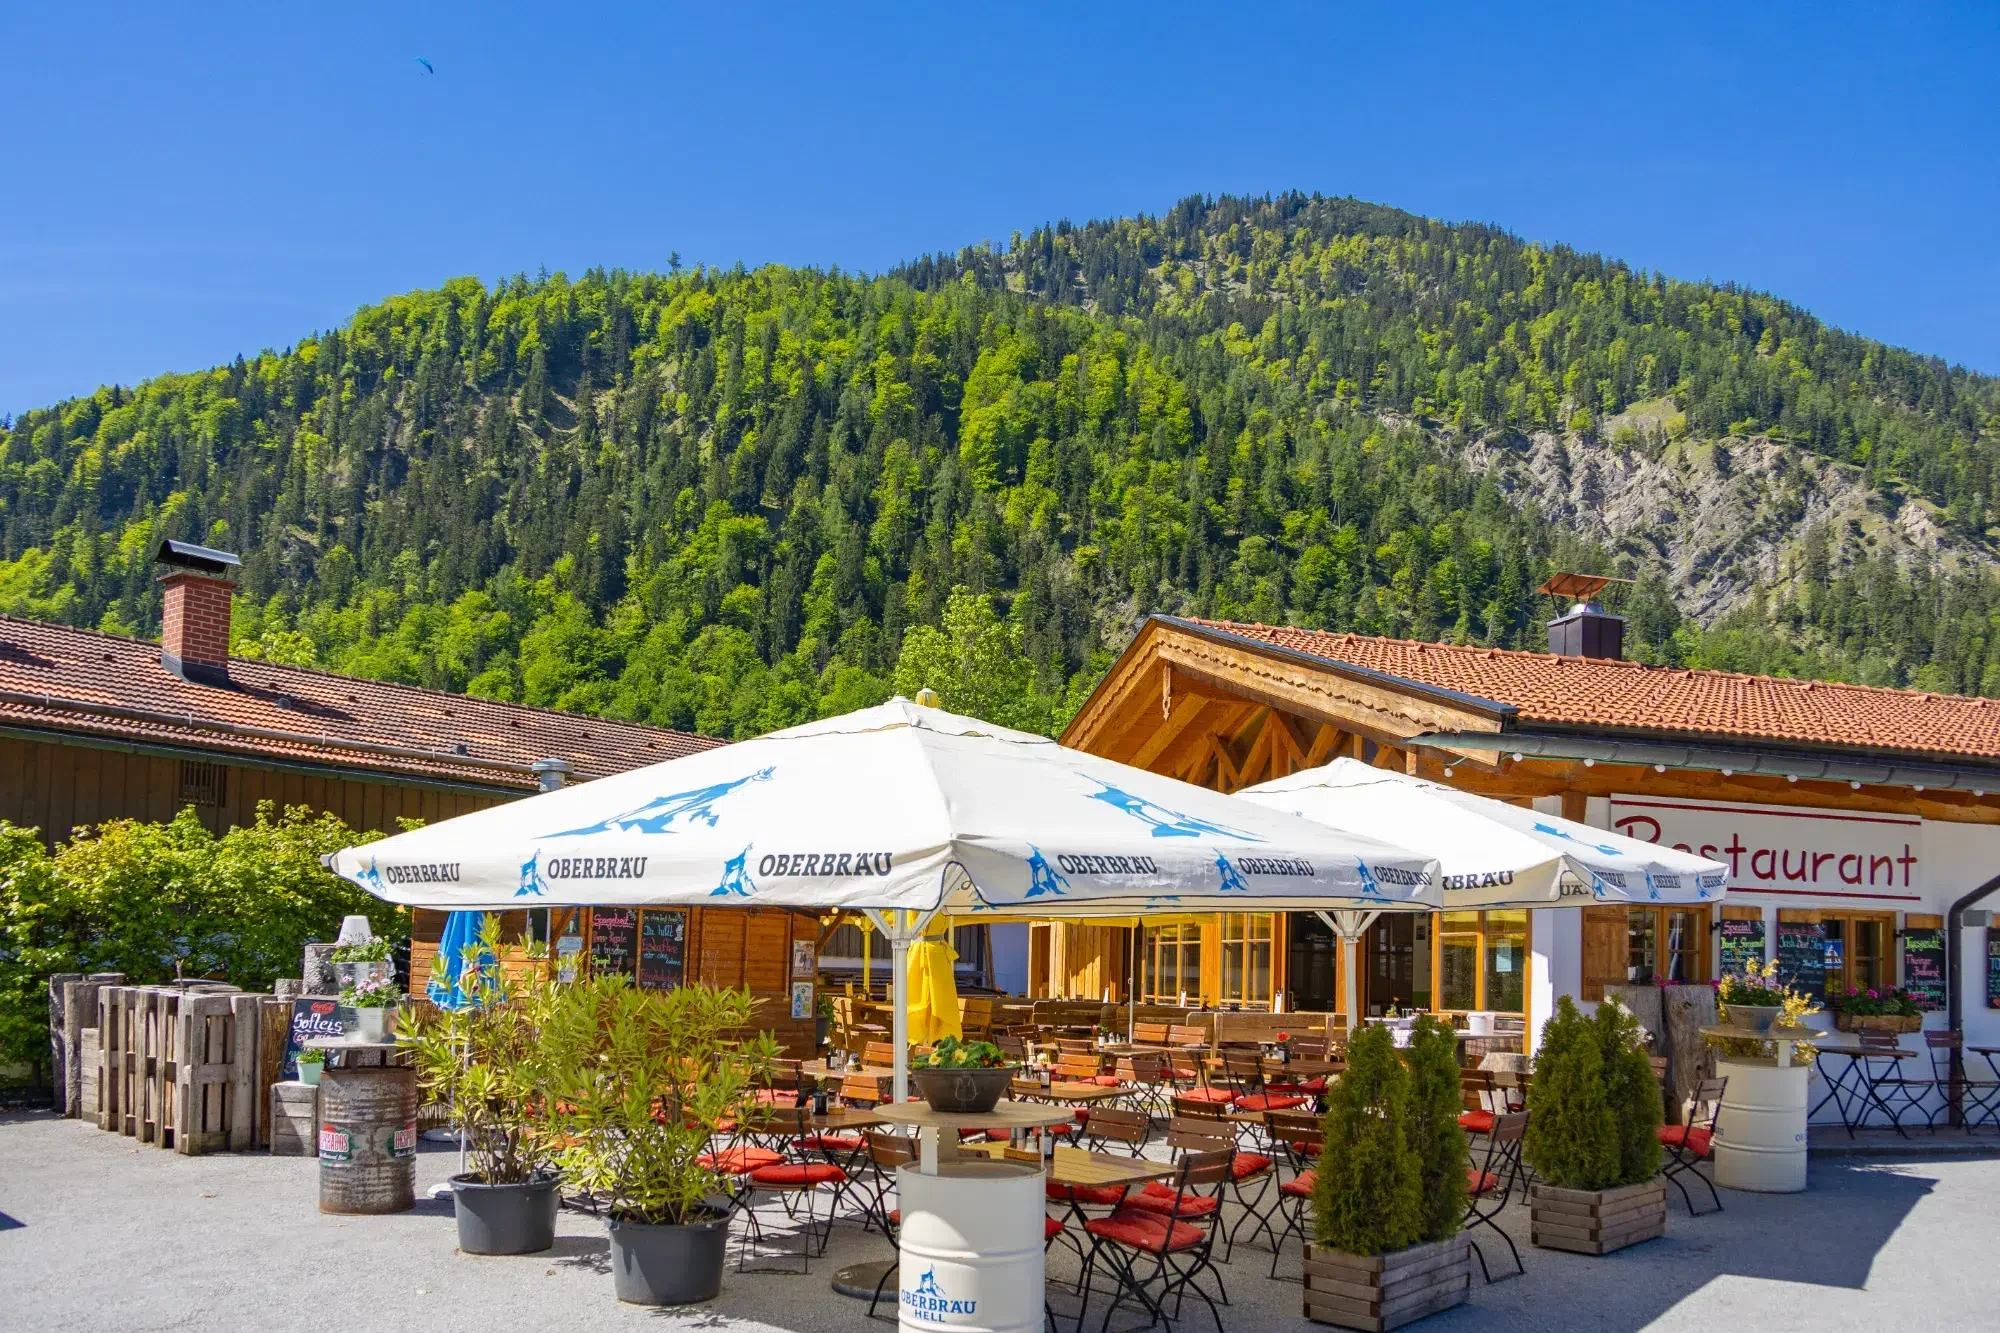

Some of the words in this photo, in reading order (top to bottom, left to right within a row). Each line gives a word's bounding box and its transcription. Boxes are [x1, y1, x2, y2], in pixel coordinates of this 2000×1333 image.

[386, 862, 461, 884] OBERBRÄU
[547, 856, 648, 879] OBERBRÄU
[758, 852, 893, 877] OBERBRÄU
[1057, 854, 1158, 876] OBERBRÄU
[1237, 857, 1314, 877] OBERBRÄU
[1374, 865, 1433, 886] OBERBRÄU
[1442, 870, 1514, 891] RBRÄU
[643, 925, 656, 936] Da
[901, 1289, 977, 1315] OBERBRÄU
[914, 1309, 946, 1323] HELL
